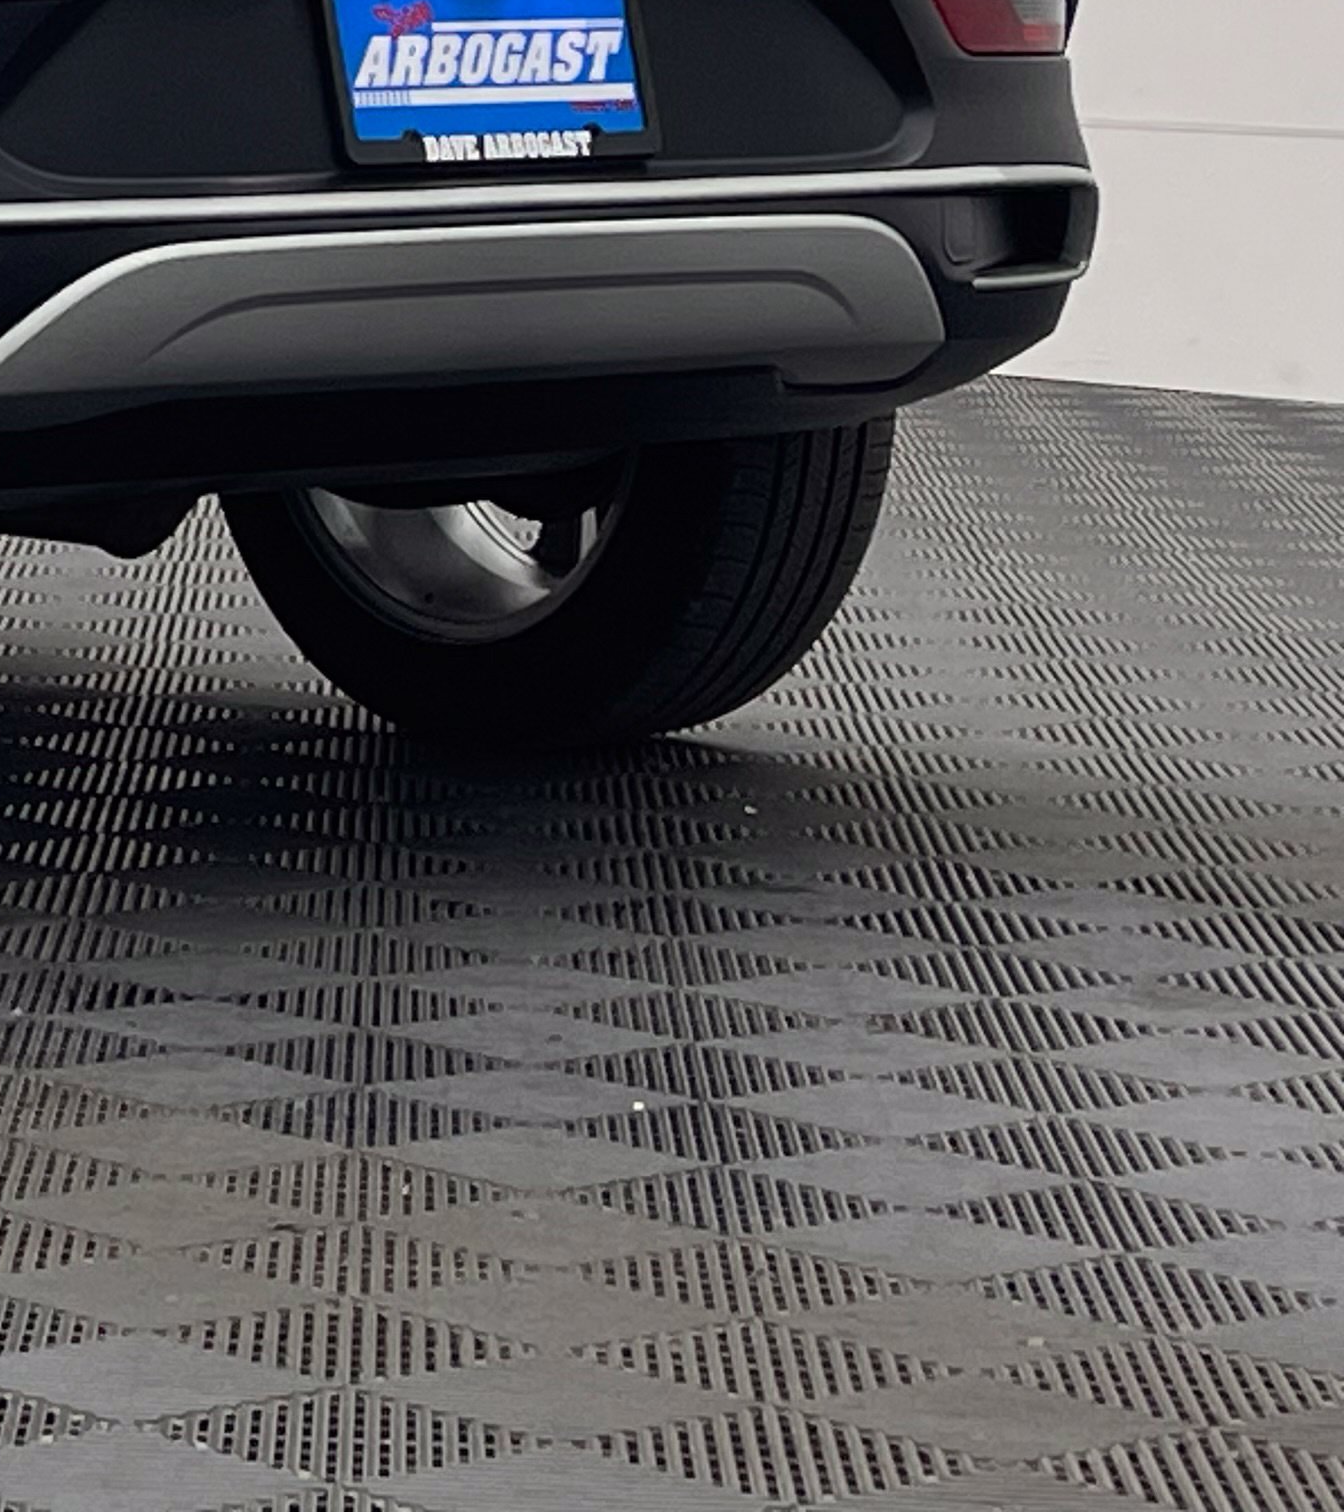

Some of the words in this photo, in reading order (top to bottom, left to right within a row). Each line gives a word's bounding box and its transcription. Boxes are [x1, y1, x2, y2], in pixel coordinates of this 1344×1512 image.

[354, 31, 623, 88] ARBOGAST
[423, 134, 480, 162] DAVE
[483, 130, 593, 160] ARBOGAST
